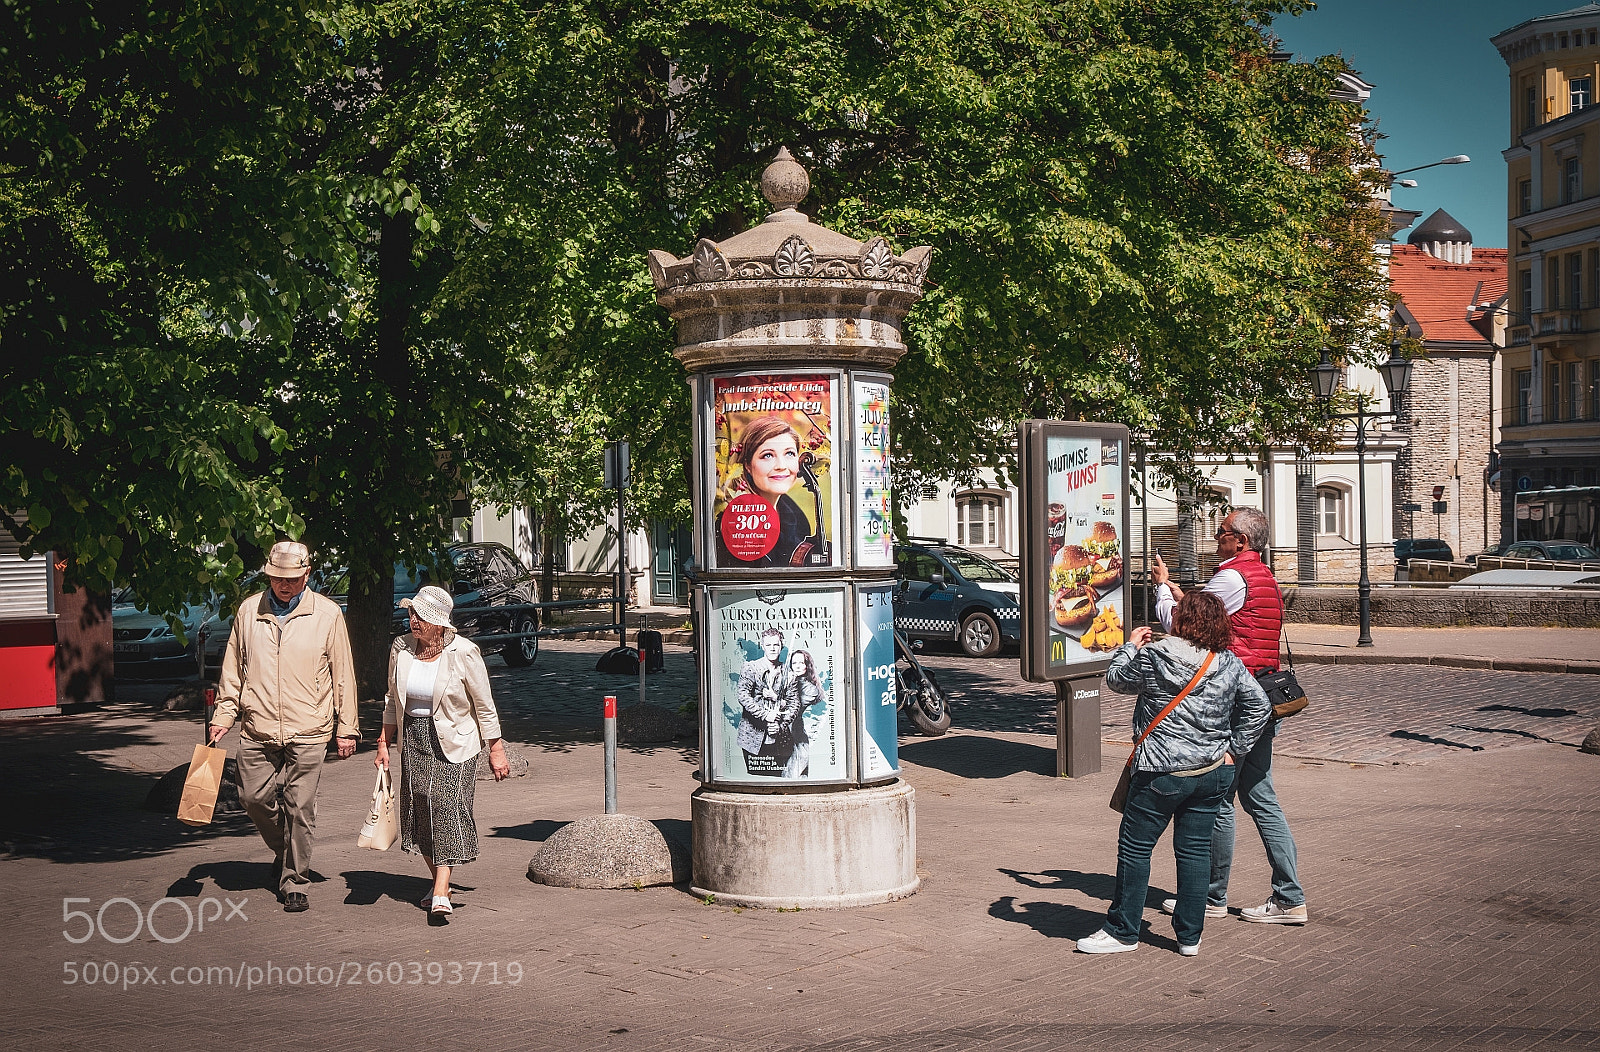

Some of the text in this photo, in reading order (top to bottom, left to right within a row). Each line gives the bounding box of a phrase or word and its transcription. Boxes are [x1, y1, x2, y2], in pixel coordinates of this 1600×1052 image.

[1066, 462, 1099, 493] KUNST
[731, 504, 767, 513] PILETID
[720, 606, 832, 621] VÜRST GABRIEL
[721, 620, 832, 631] EHK PIRITA KLOOSTRI
[1073, 689, 1099, 700] JCDecaux
